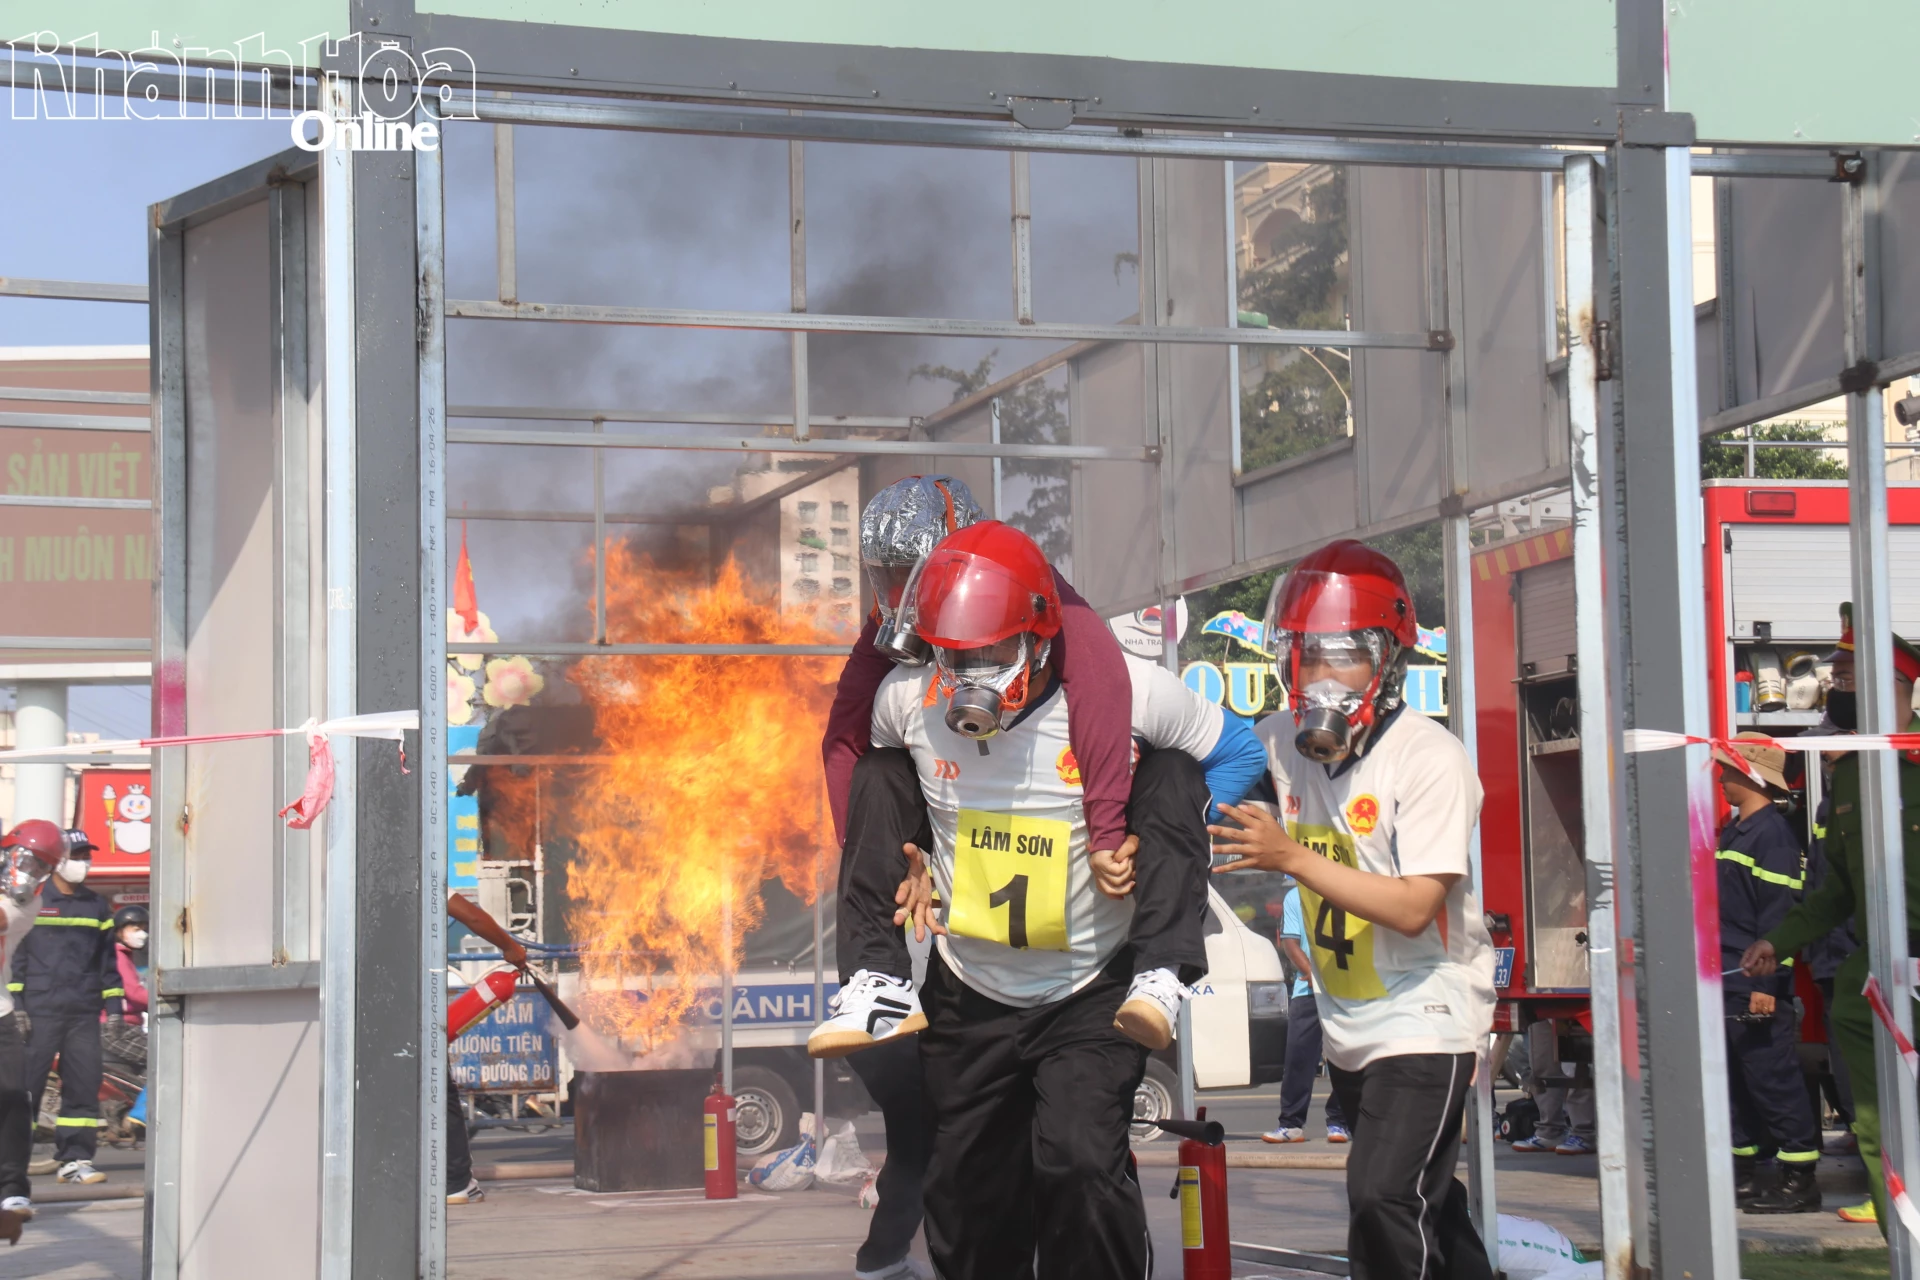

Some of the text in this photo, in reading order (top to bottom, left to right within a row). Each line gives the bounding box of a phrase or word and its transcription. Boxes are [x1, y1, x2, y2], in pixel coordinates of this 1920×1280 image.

[428, 406, 436, 476] 16/04/26
[428, 490, 436, 507] M4
[25, 525, 115, 582] MUÔN
[124, 534, 151, 581] N
[1125, 638, 1143, 646] NHA
[428, 665, 436, 701] 6000
[428, 727, 437, 745] 40
[429, 851, 437, 861] A
[971, 826, 1054, 858] LÂM SƠN
[1297, 836, 1328, 858] ÂM
[429, 869, 437, 915] GRADE
[989, 873, 1029, 949] 1
[1314, 897, 1354, 971] 4
[494, 995, 533, 1025] CẤM
[429, 1067, 438, 1104] ASTM
[430, 1113, 438, 1130] MY
[430, 1139, 438, 1187] CHUAN
[430, 1194, 438, 1231] TIEU
[430, 1260, 438, 1280] IA
